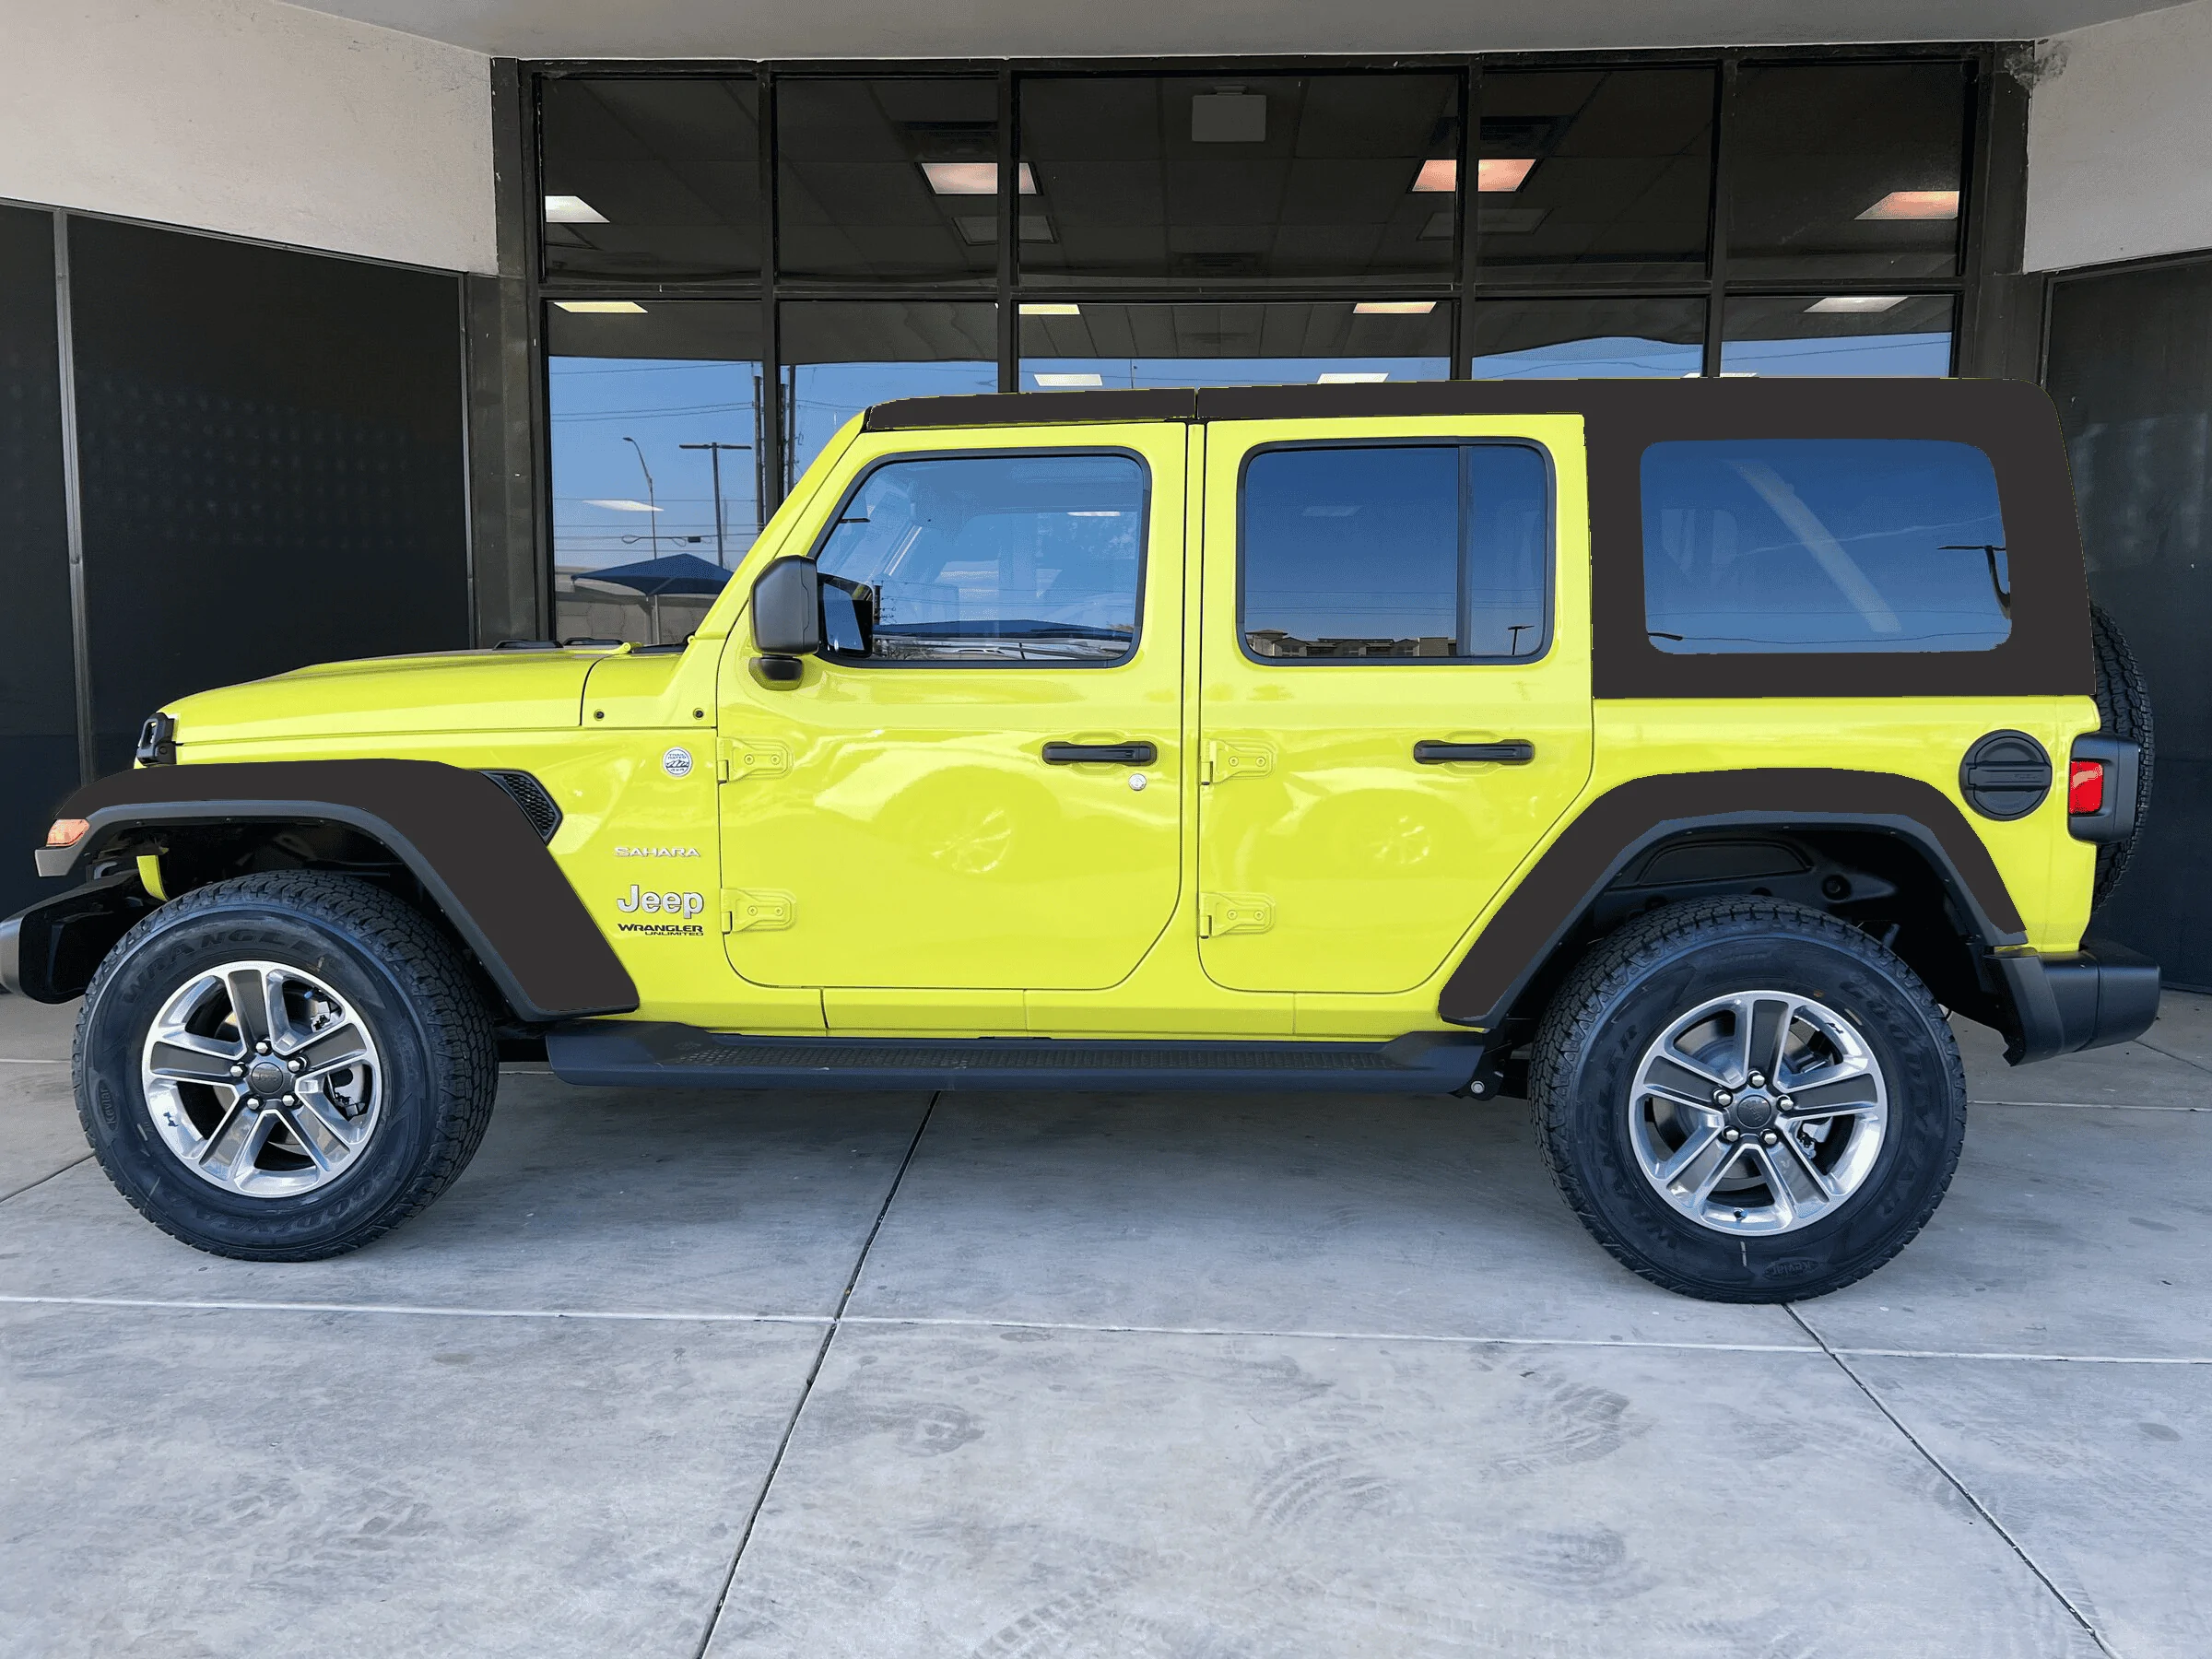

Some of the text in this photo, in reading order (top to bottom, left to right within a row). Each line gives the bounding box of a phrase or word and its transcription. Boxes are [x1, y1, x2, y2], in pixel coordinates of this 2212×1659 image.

[615, 847, 700, 857] SAHARA
[617, 884, 704, 919] Jeep
[618, 923, 703, 932] WRANGLER
[100, 1089, 117, 1124] Kevlar
